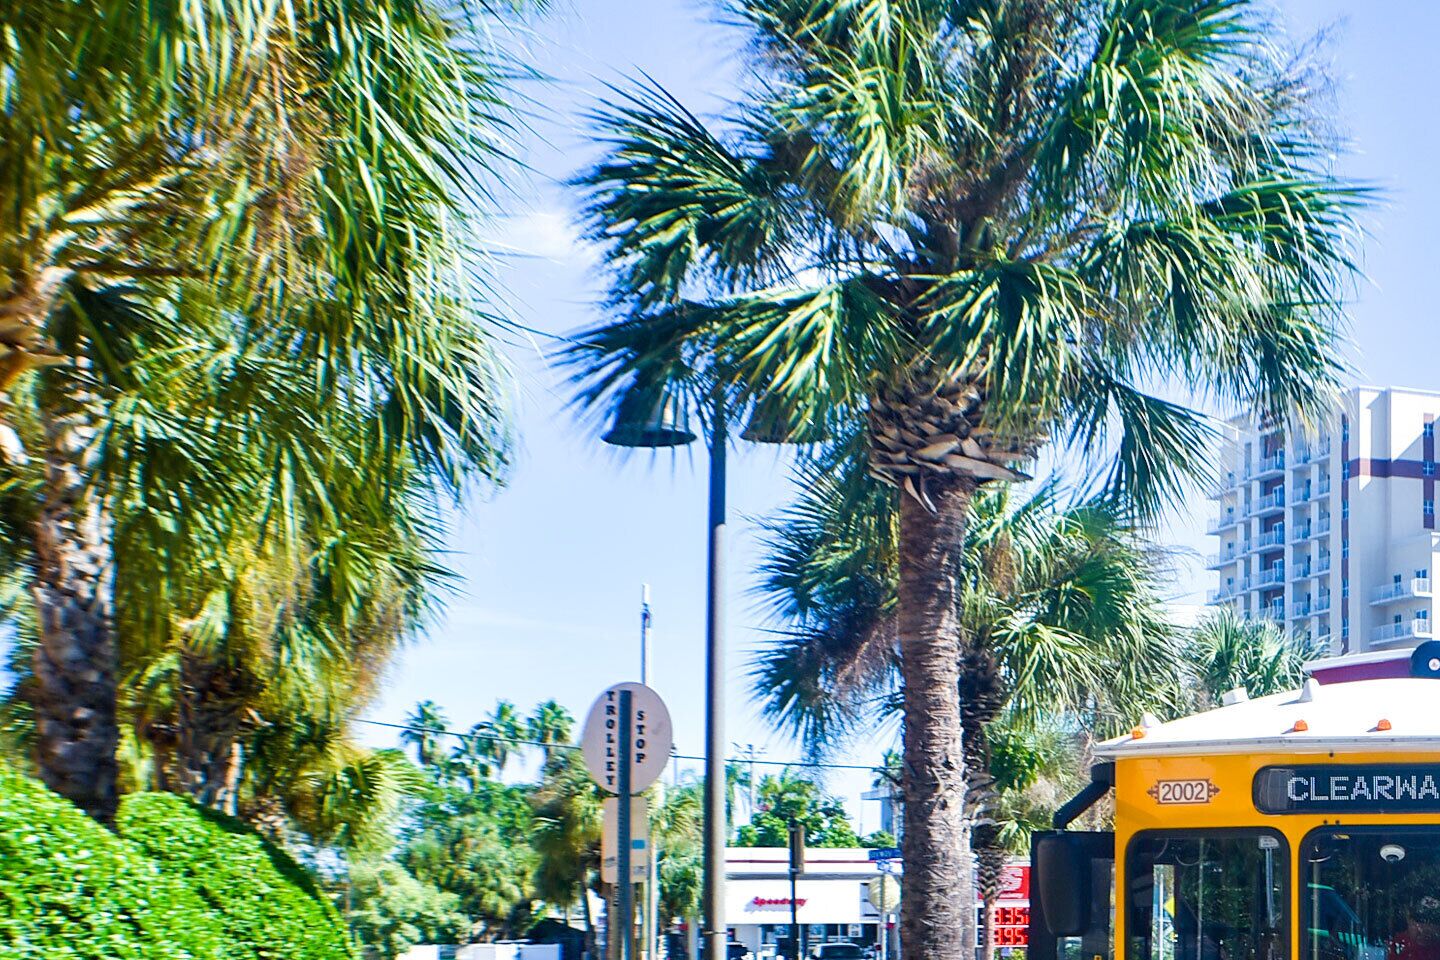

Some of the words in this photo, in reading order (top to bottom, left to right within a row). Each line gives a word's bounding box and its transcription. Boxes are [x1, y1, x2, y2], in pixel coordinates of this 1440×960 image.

[605, 690, 616, 786] TROLLEY
[635, 710, 646, 764] STOP
[1161, 782, 1205, 802] 2002
